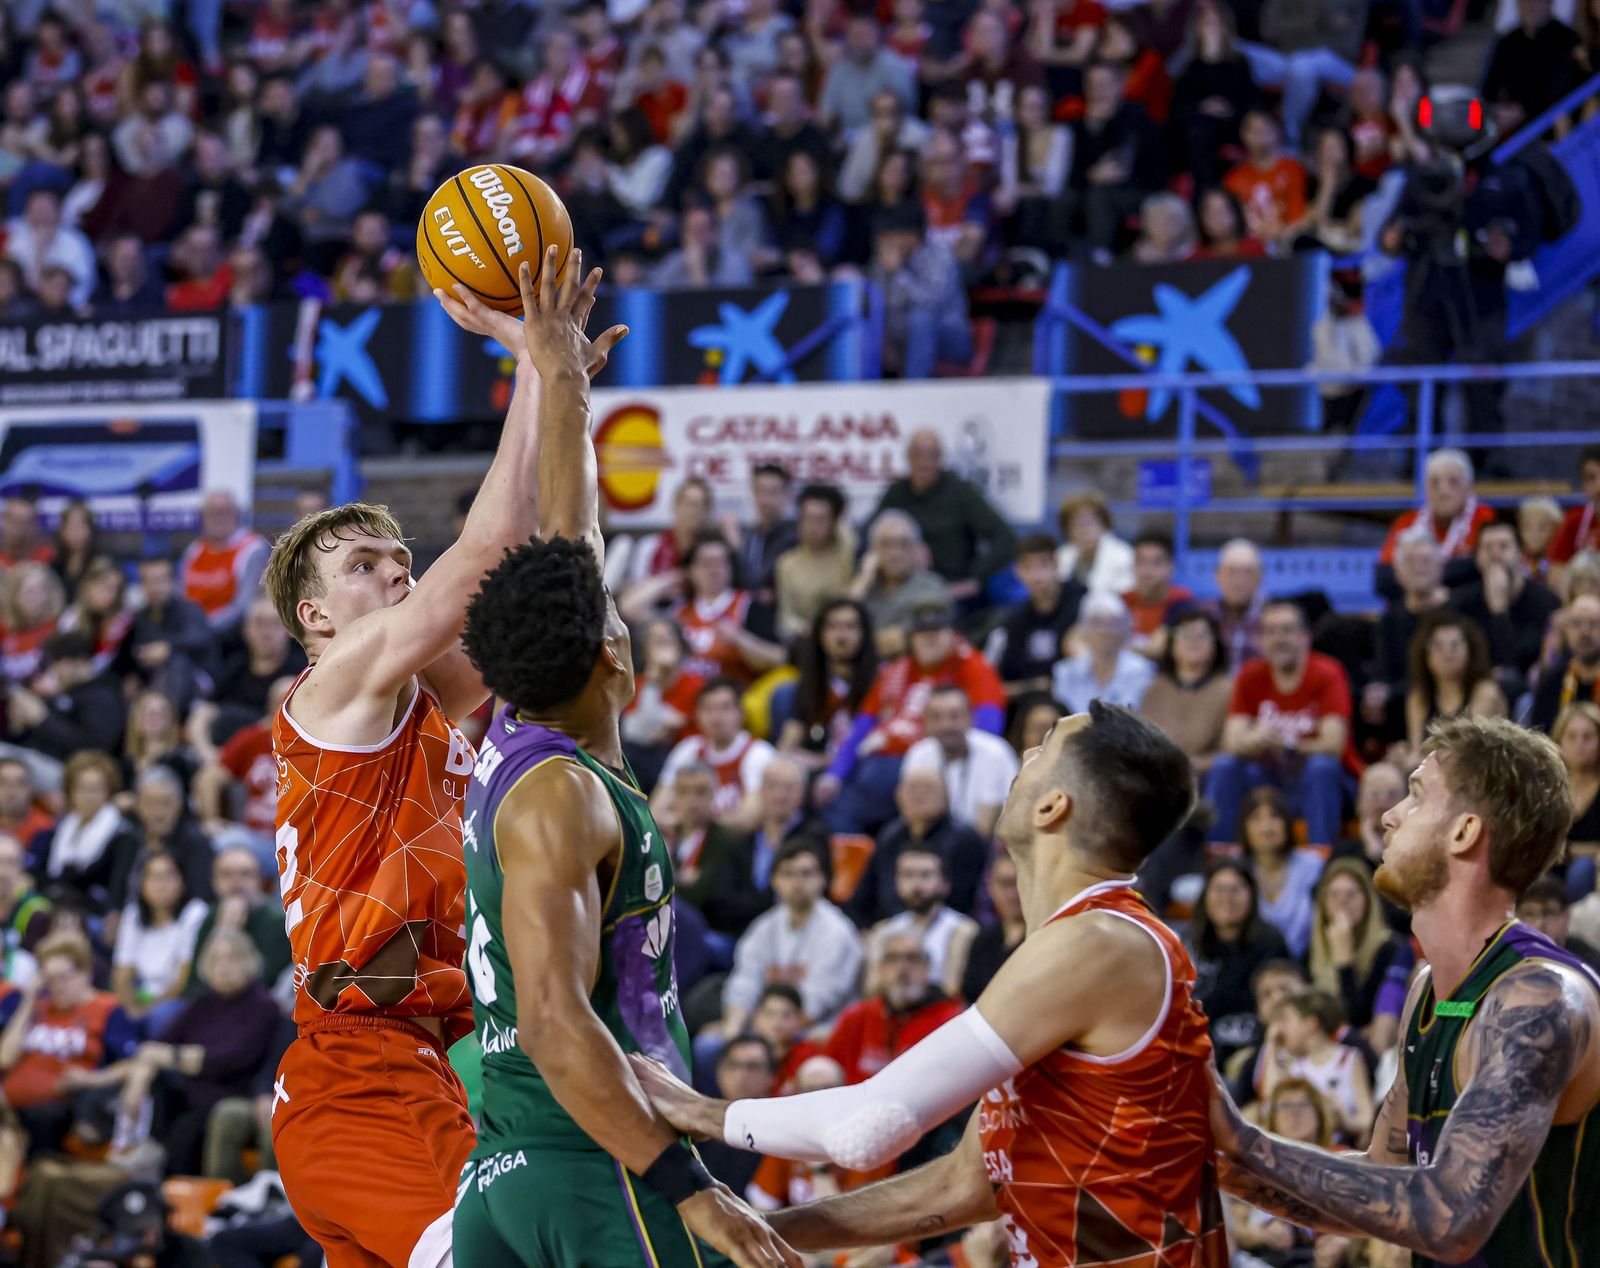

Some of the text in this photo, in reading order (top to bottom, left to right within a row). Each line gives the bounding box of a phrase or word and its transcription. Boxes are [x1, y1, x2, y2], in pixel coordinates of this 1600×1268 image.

[433, 206, 487, 270] EVO NXT
[469, 167, 526, 258] Wilson
[685, 412, 901, 446] CATALANA
